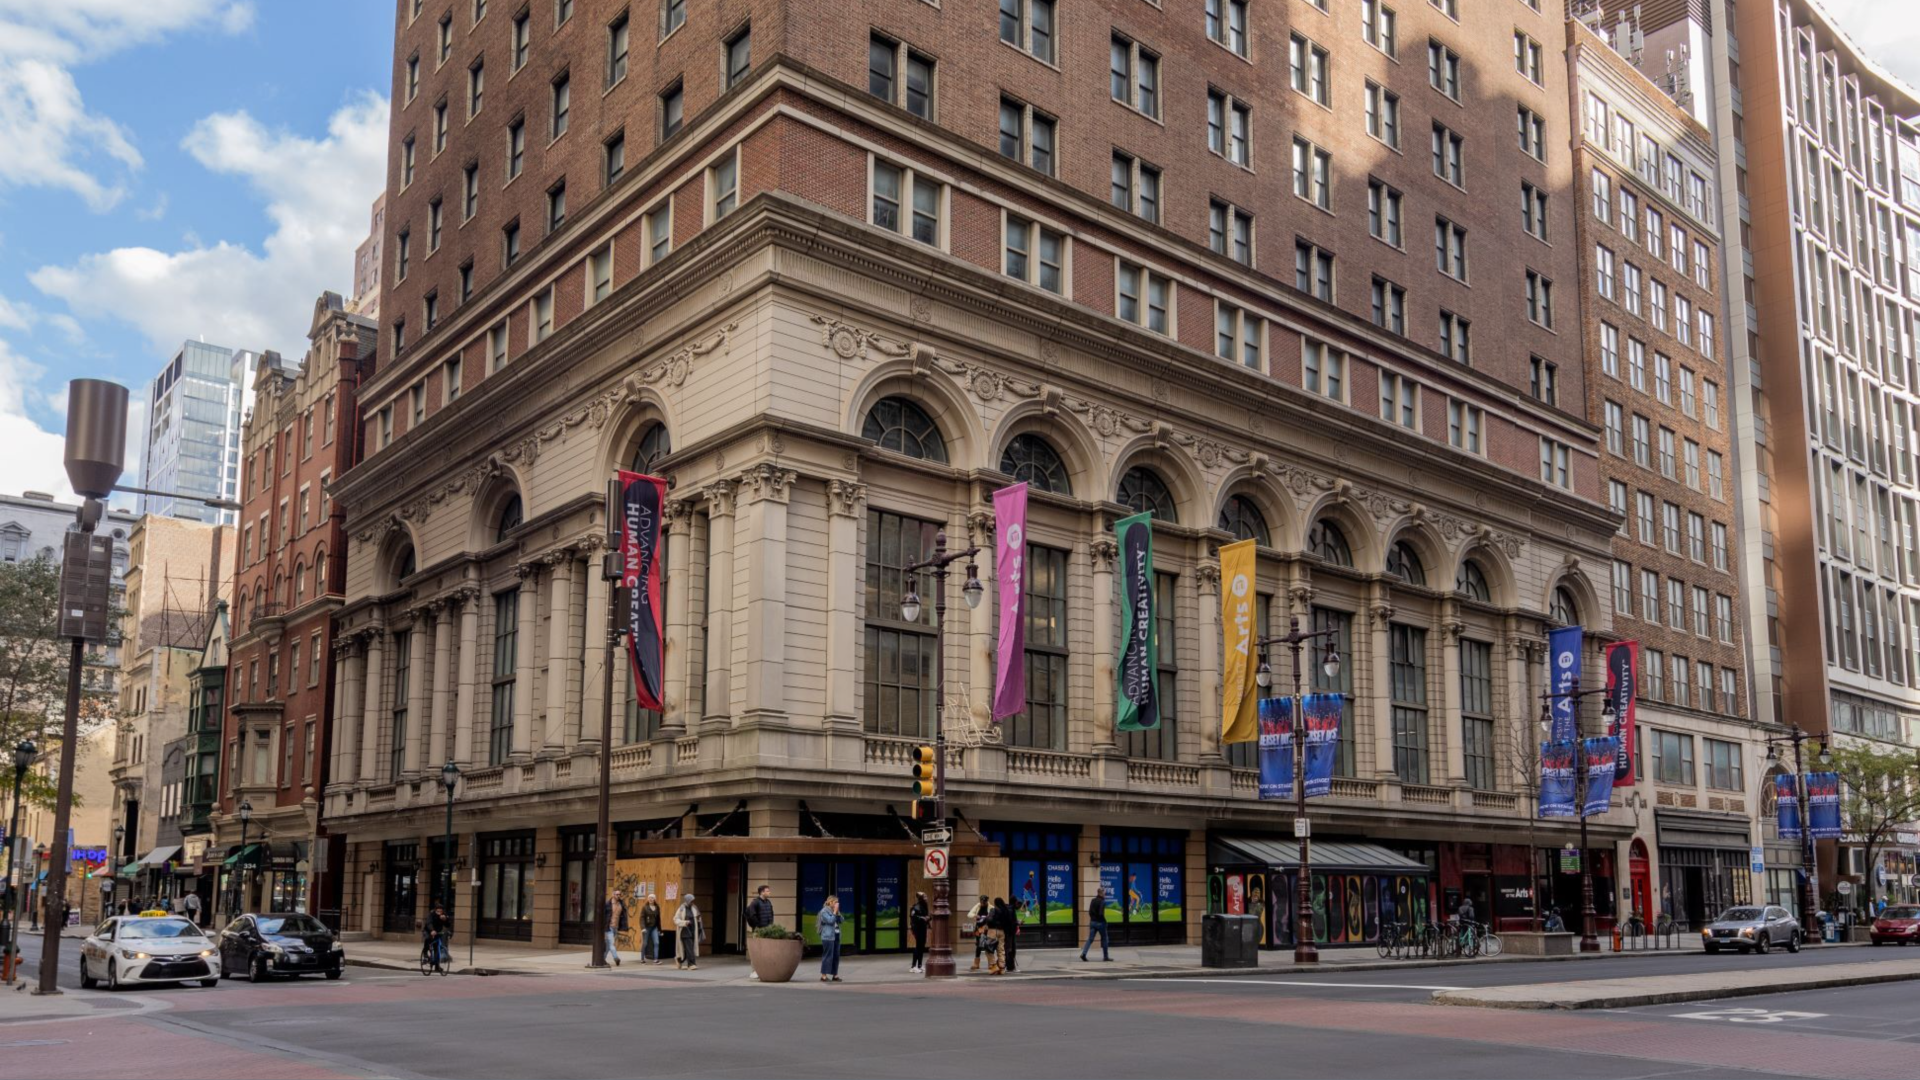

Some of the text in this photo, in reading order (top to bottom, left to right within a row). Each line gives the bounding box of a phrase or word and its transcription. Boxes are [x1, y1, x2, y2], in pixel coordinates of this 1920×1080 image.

[626, 503, 640, 569] HUMAN
[1235, 602, 1250, 656] Arts
[1138, 646, 1149, 704] HUMAN
[1618, 728, 1628, 769] HUMAN
[1047, 875, 1062, 883] Hello
[1047, 889, 1059, 898] City
[1159, 890, 1169, 898] City
[1515, 887, 1529, 898] Arts
